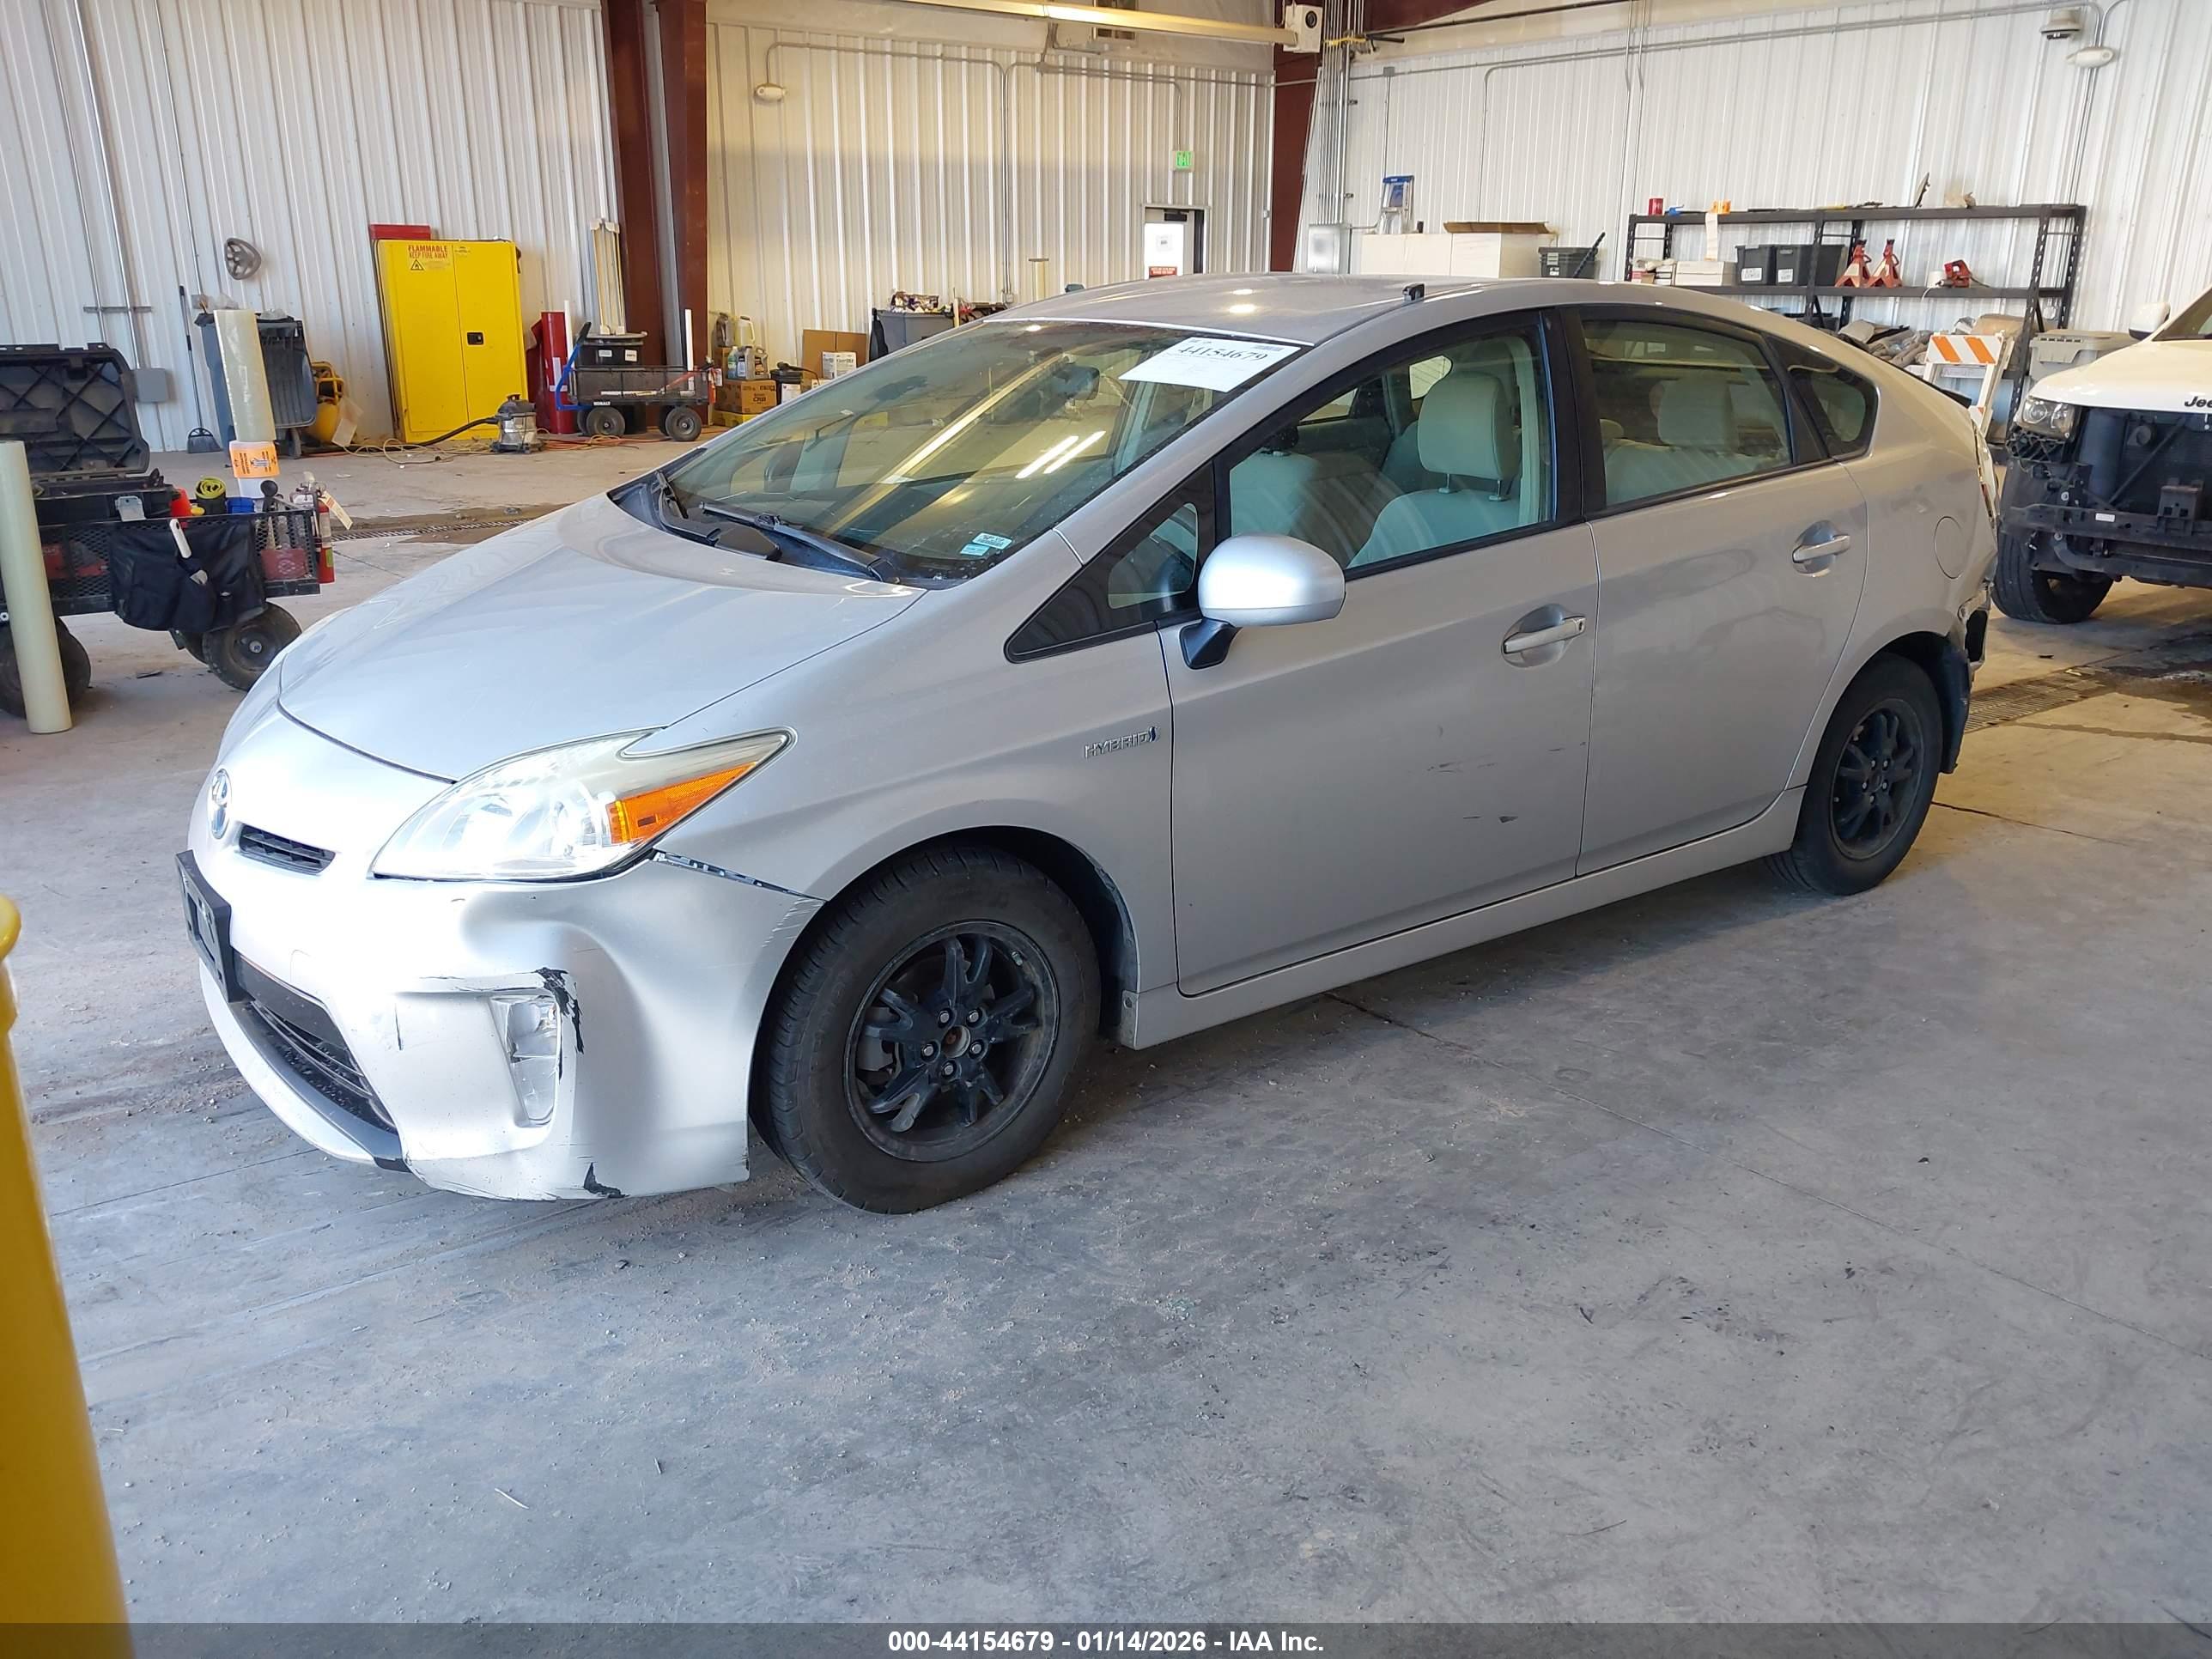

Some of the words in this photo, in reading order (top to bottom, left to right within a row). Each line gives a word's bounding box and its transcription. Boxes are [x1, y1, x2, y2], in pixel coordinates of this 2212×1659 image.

[1178, 346, 1268, 361] 44154679
[2184, 396, 2212, 408] Jee
[1084, 732, 1148, 759] HYBRID
